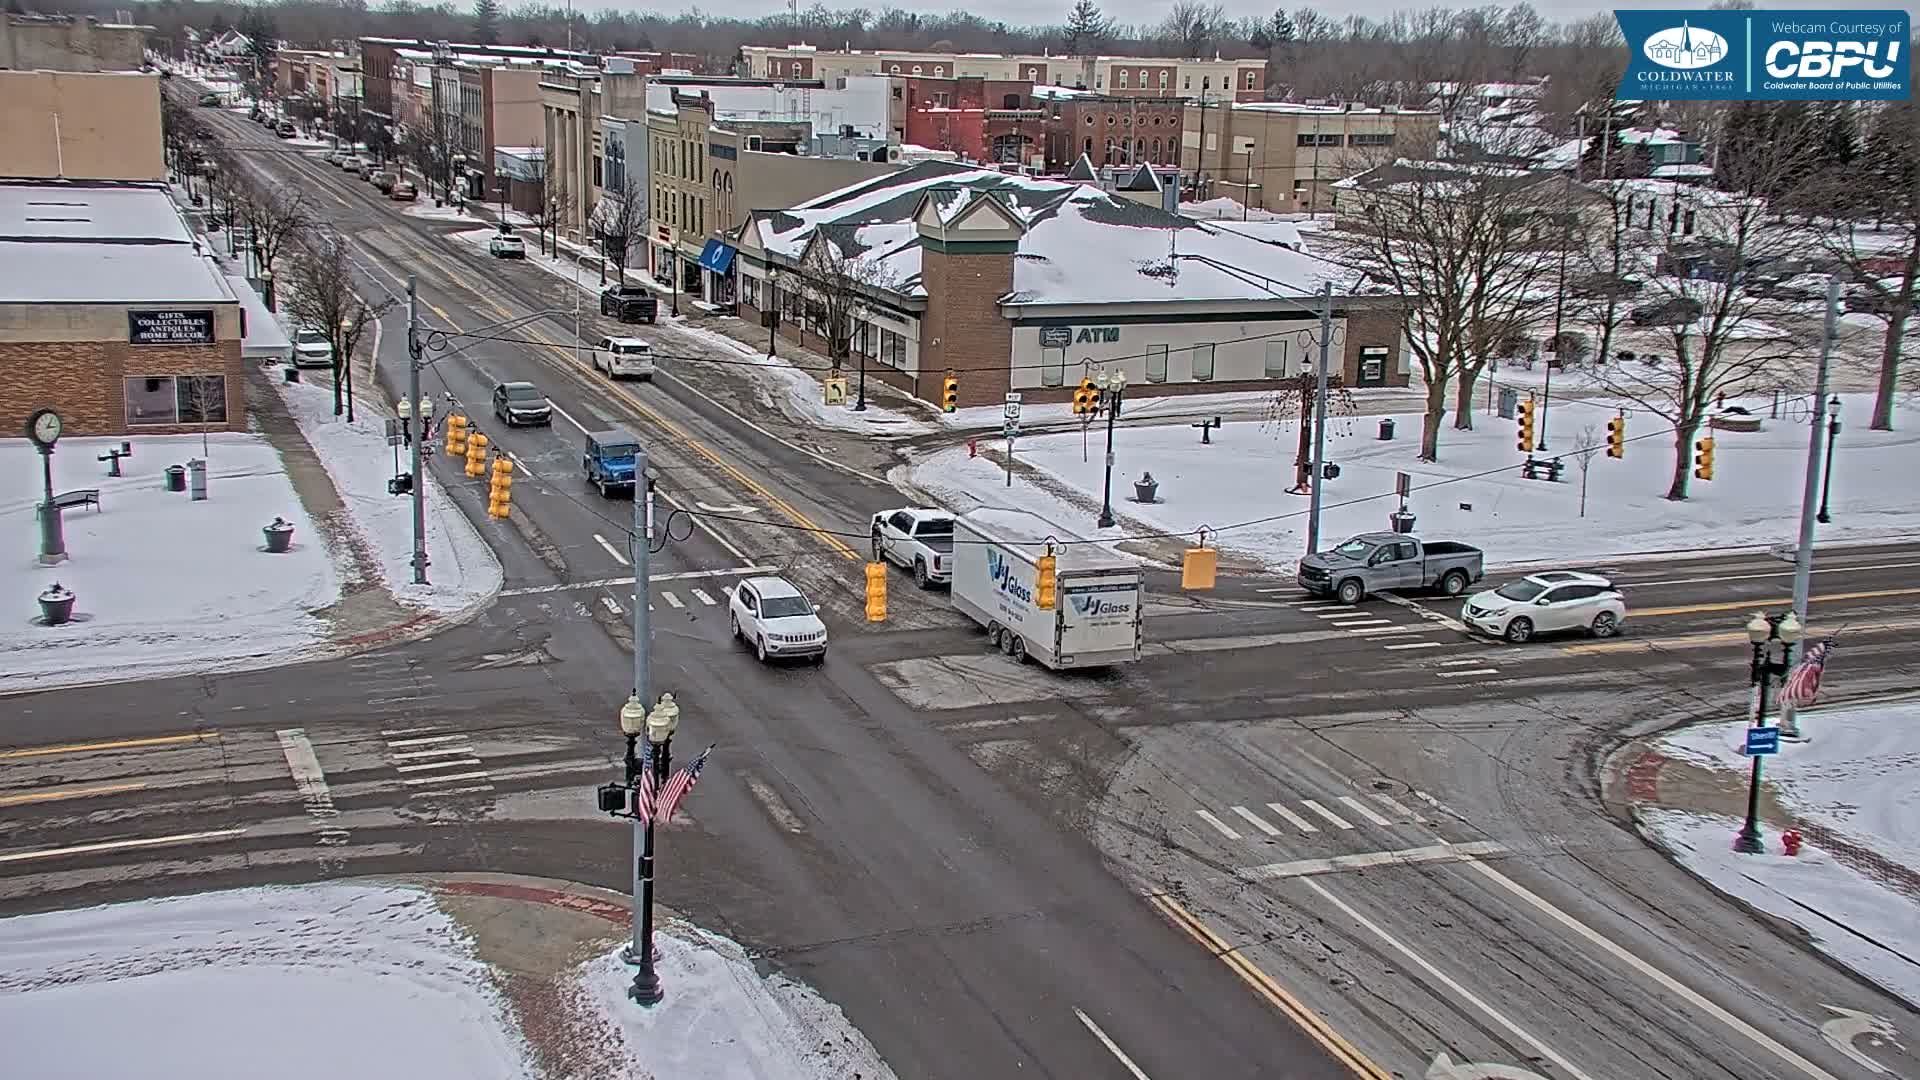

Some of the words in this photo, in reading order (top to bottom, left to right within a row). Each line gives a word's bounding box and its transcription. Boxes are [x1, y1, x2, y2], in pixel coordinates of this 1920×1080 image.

[1075, 327, 1120, 344] ATM
[1007, 404, 1018, 415] 12
[1008, 575, 1031, 603] Glass
[1100, 602, 1131, 614] Glass
